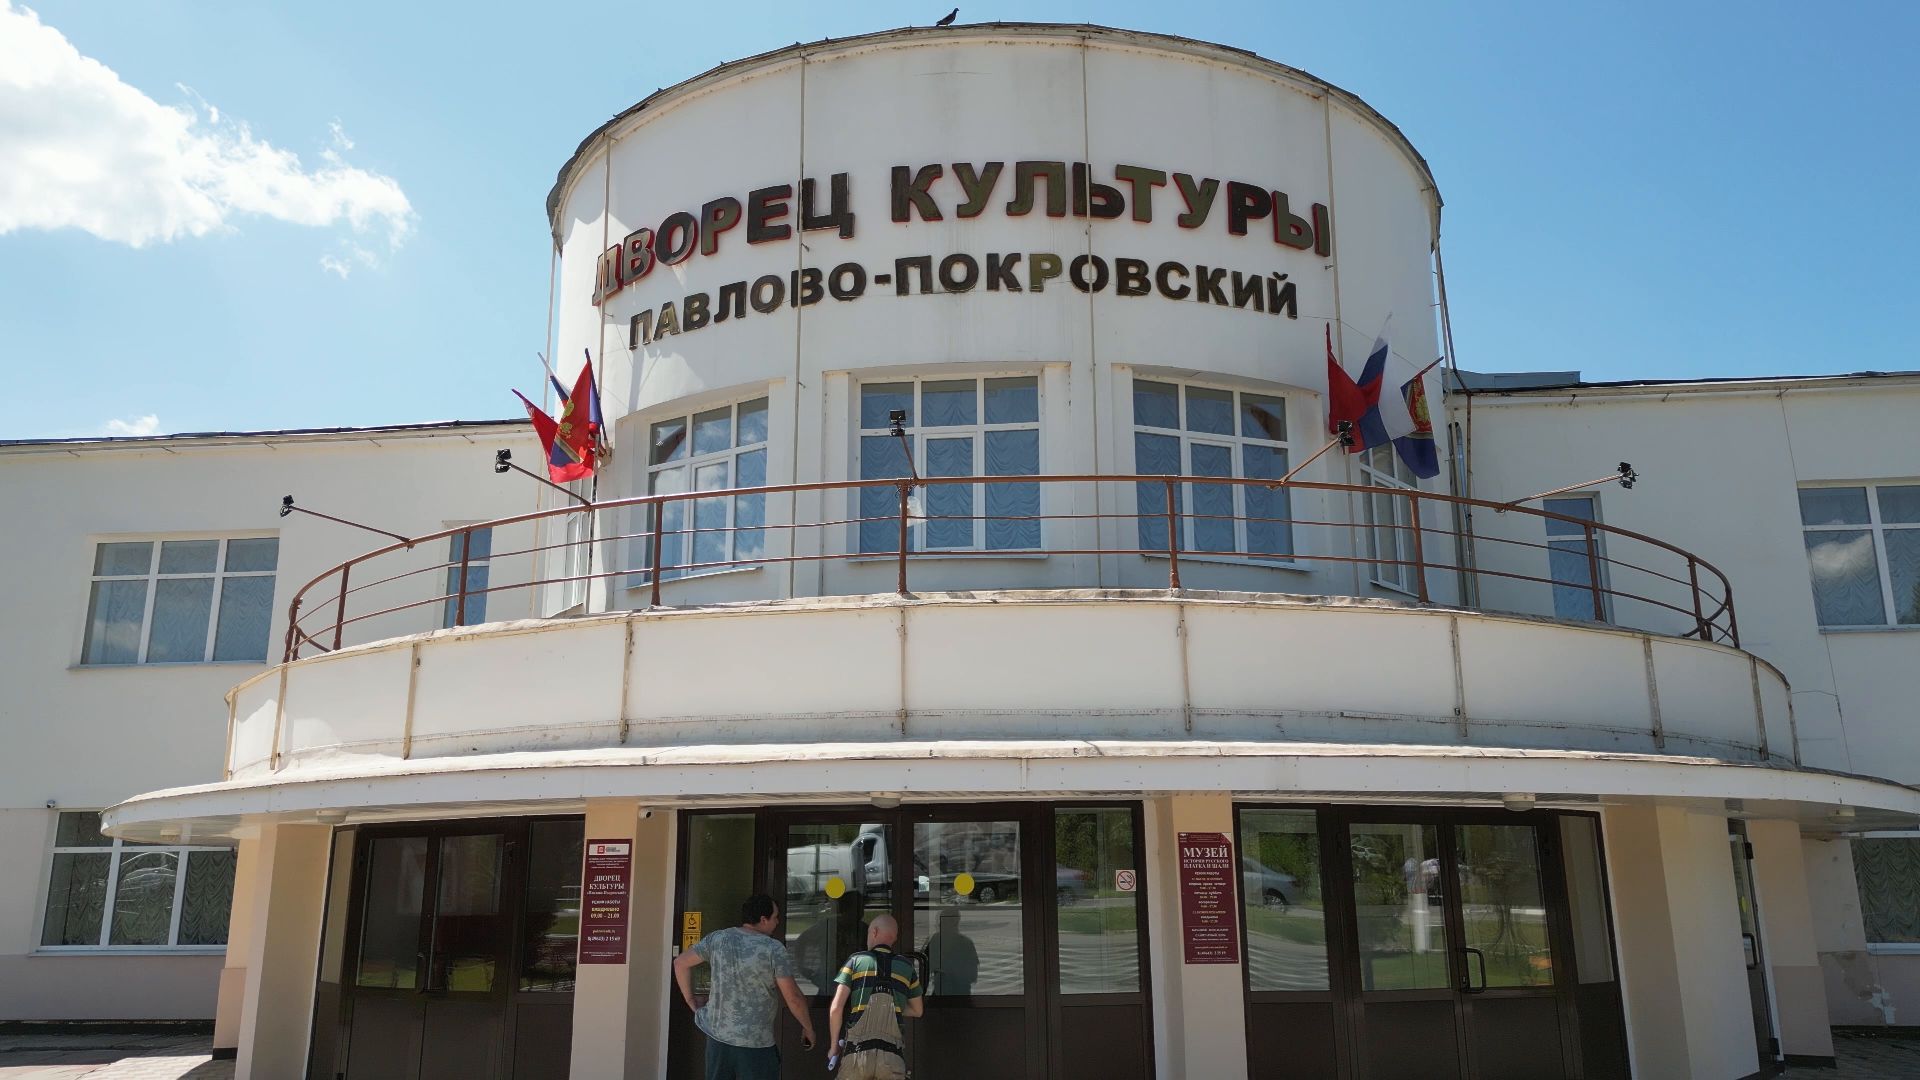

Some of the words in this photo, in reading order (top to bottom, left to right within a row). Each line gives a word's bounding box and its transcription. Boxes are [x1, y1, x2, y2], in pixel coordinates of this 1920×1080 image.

[592, 172, 855, 306] ДВОРЕЦ
[890, 161, 1331, 257] КУЛЬТУРЫ
[629, 253, 1298, 350] ПАВЛОВО-ПОКРОВСКИЙ
[1184, 845, 1228, 858] МУЗЕЙ
